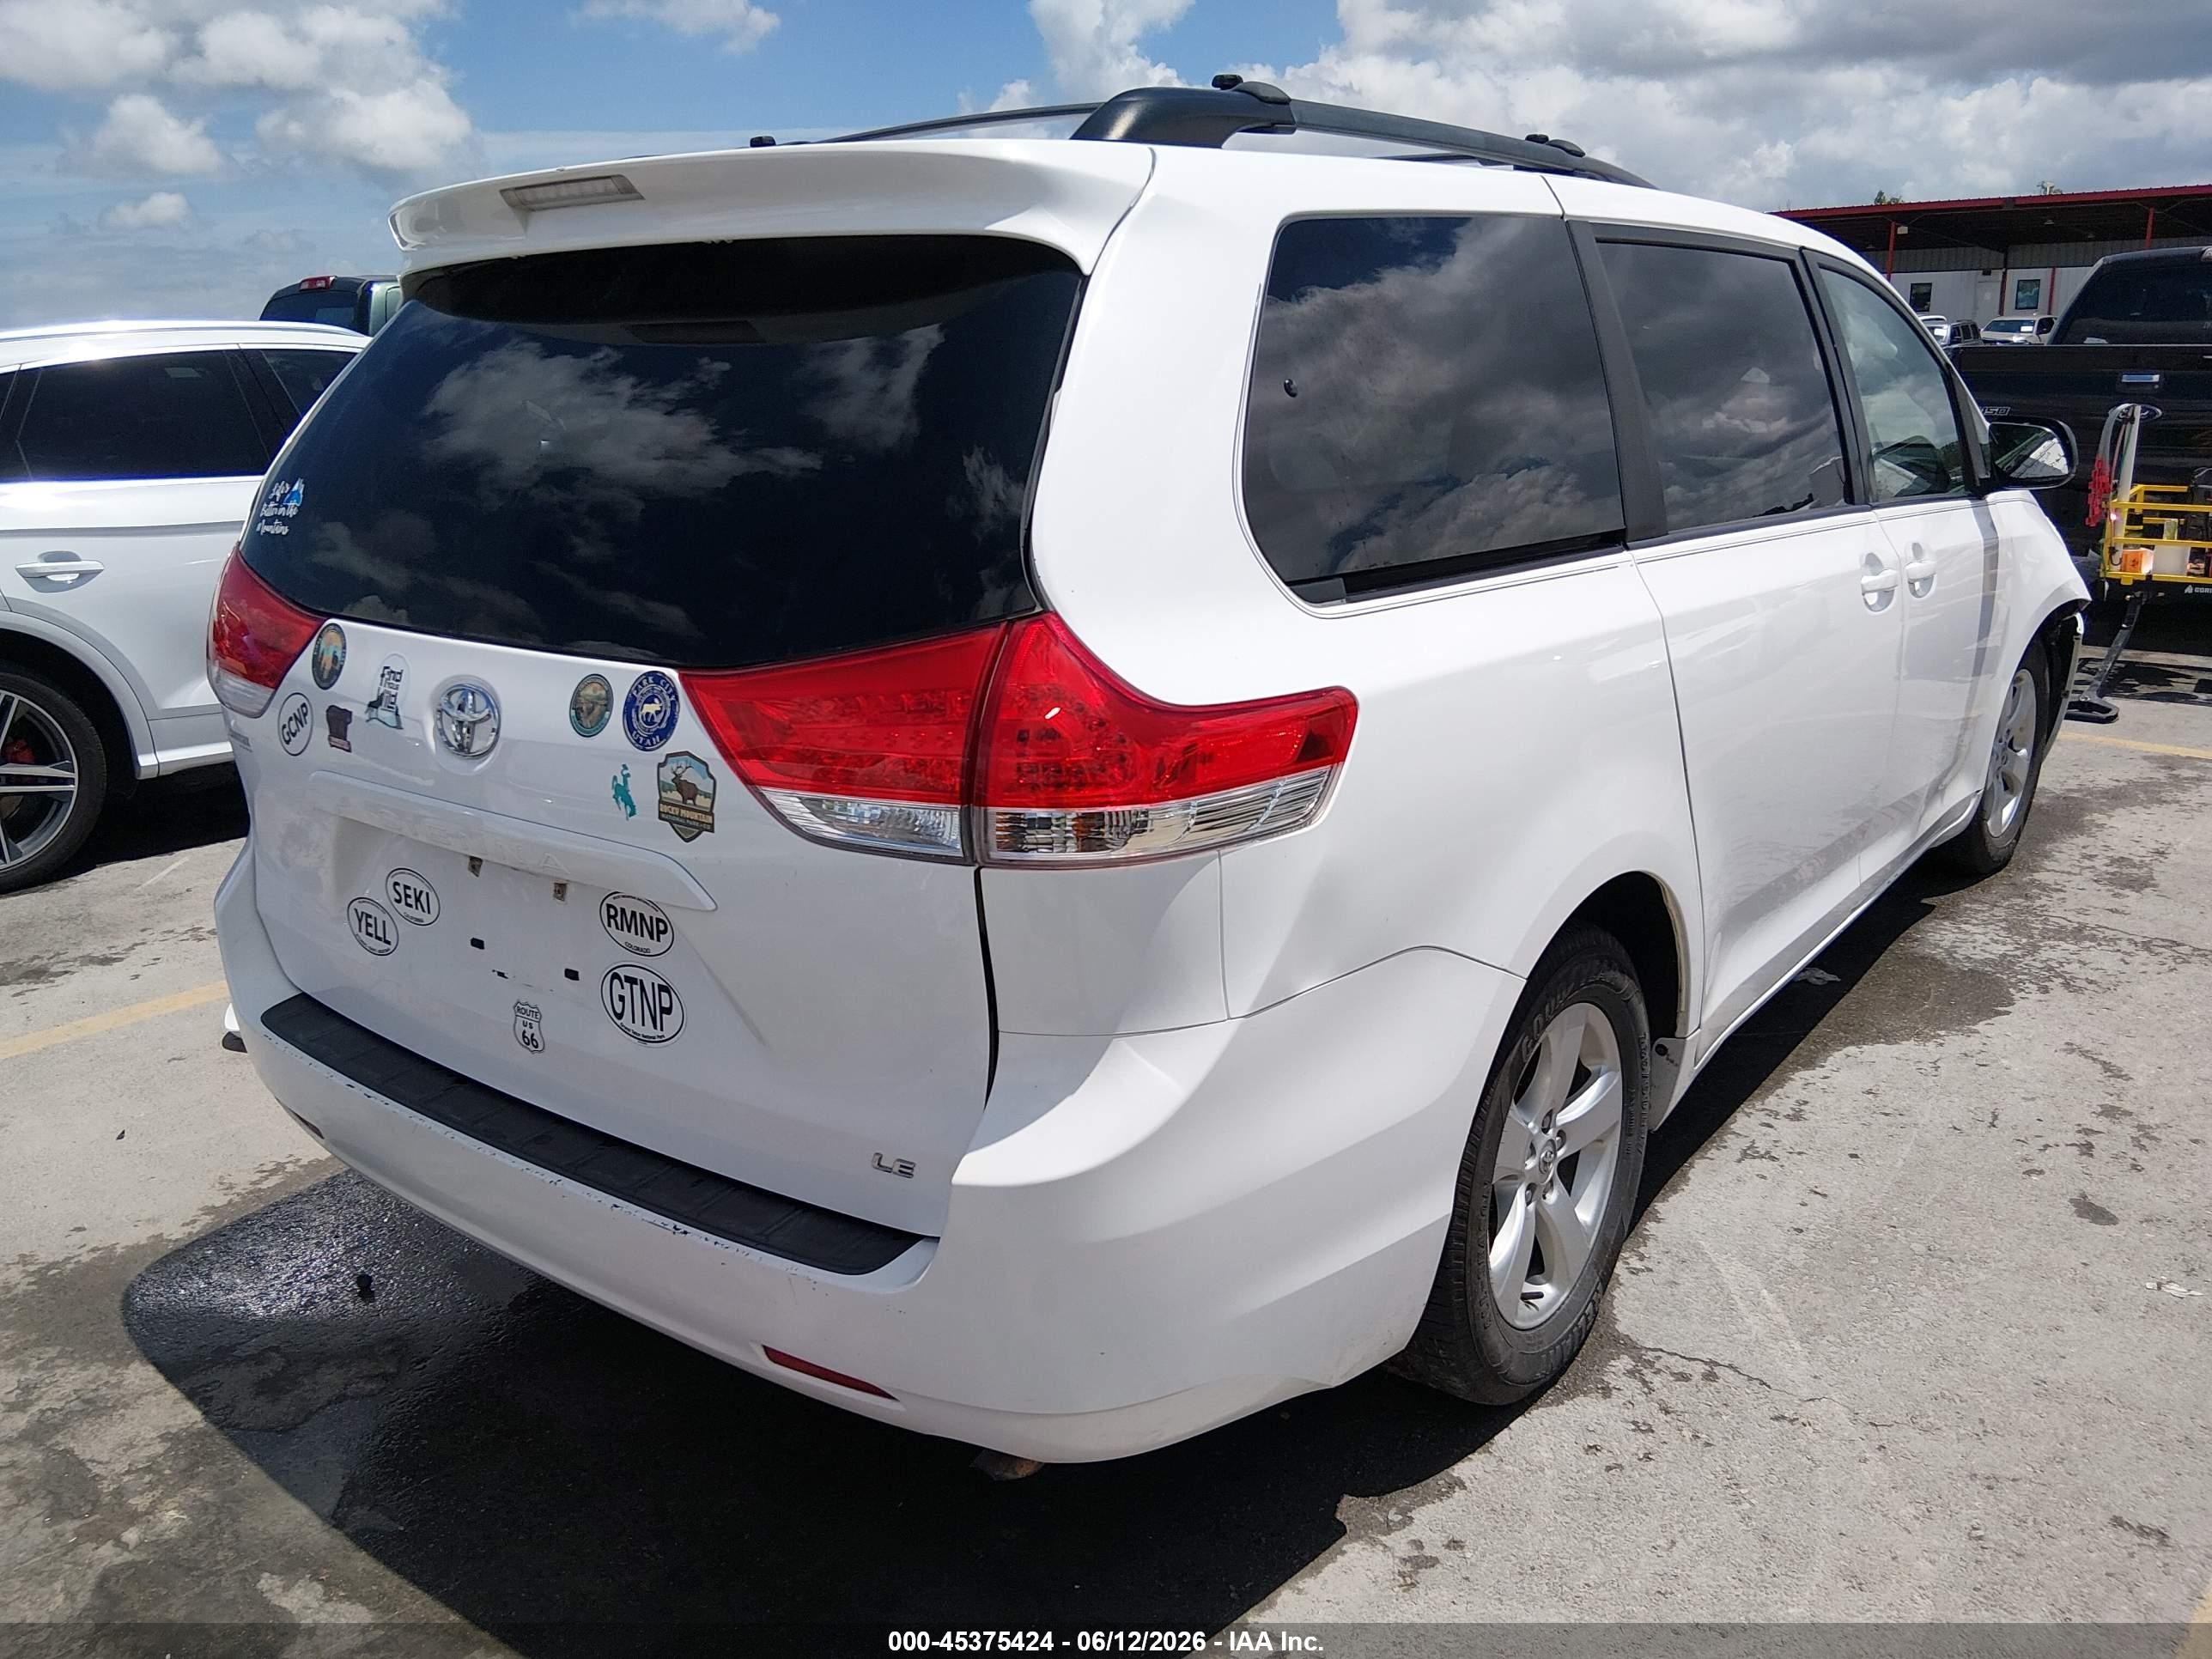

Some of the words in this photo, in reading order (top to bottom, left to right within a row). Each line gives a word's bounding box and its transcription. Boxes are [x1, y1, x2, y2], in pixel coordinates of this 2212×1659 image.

[632, 676, 655, 696] PARK
[659, 678, 677, 701] CITY
[281, 702, 309, 745] GCNP
[631, 731, 660, 747] UTAH
[392, 881, 431, 915] SEKI
[353, 908, 392, 946] YELL
[605, 902, 669, 943] RMNP
[516, 1006, 540, 1020] ROUTE
[609, 971, 673, 1032] GTNP
[521, 1030, 538, 1048] 66
[871, 1152, 916, 1179] LE
